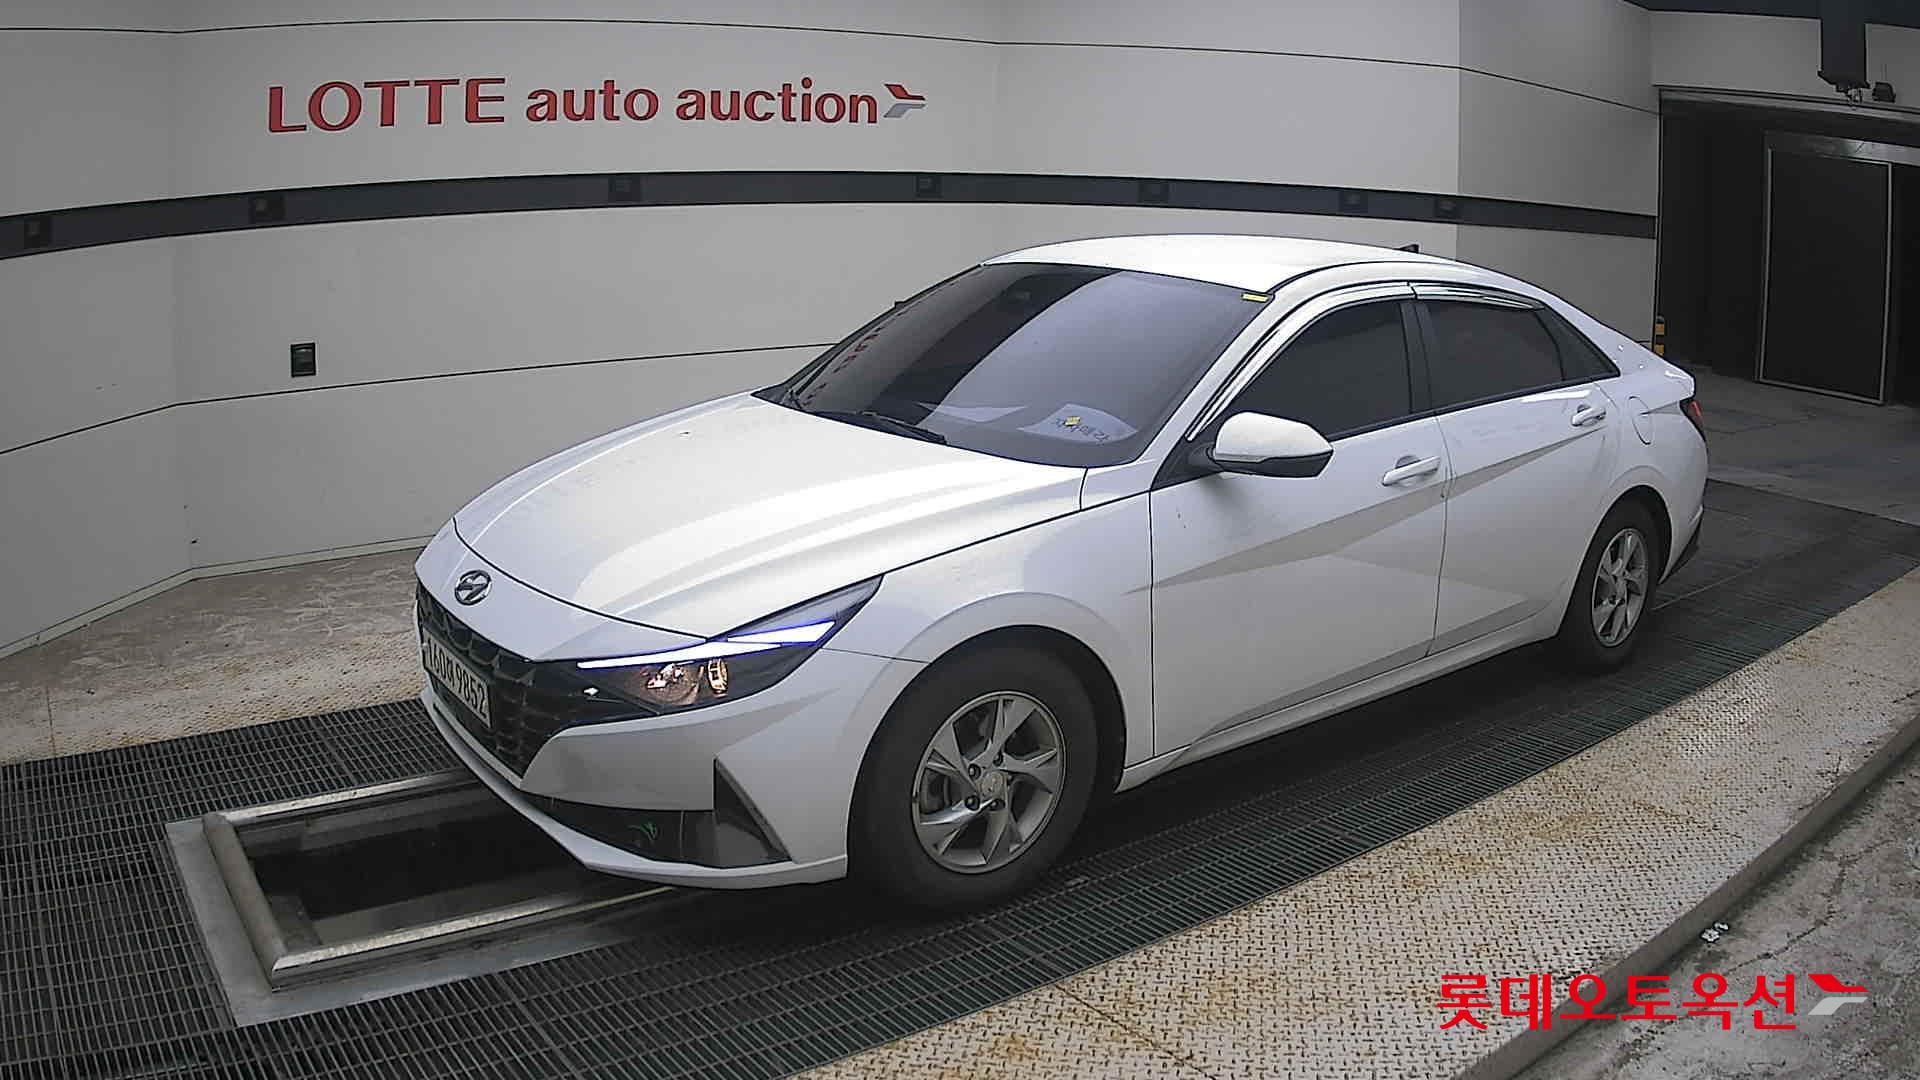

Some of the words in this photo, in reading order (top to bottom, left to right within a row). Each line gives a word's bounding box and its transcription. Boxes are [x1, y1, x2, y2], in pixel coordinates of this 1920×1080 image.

[269, 78, 505, 132] LOTTE
[526, 79, 659, 123] auto
[676, 77, 878, 123] auction
